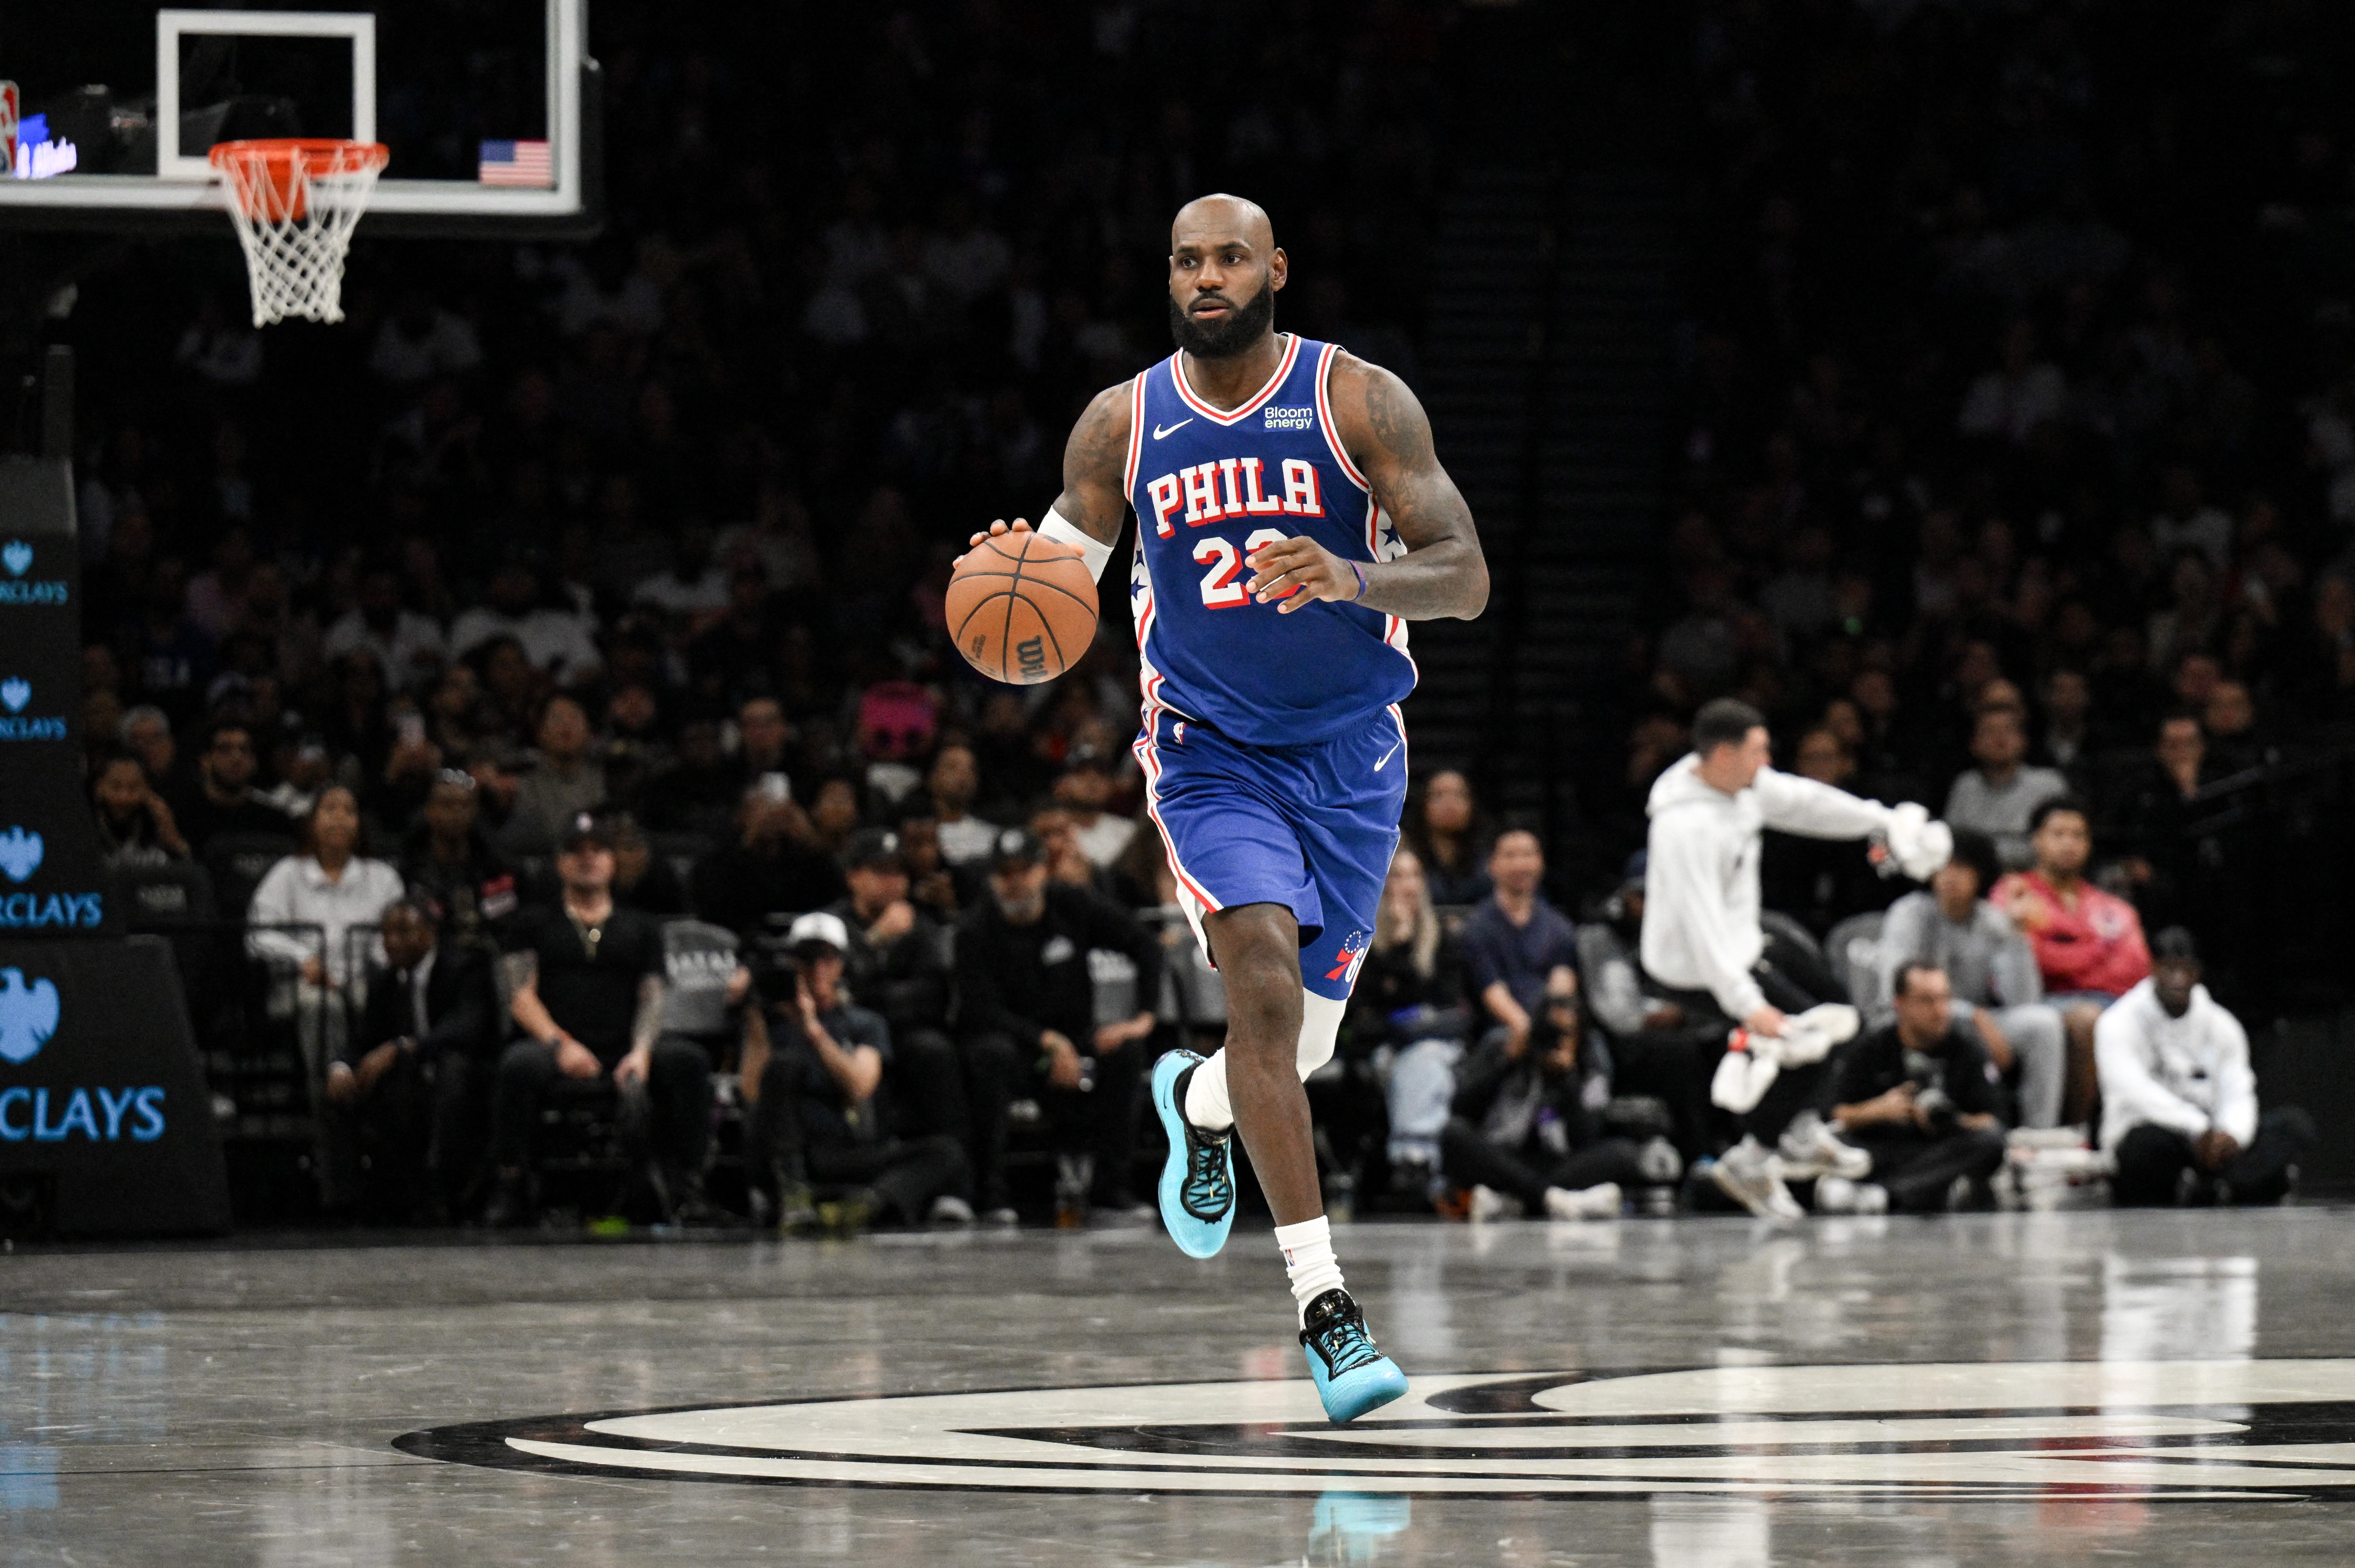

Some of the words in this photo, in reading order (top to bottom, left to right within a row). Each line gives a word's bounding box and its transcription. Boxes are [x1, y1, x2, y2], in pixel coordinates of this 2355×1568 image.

[1265, 406, 1312, 419] Bloom
[1265, 417, 1312, 429] energy
[1147, 457, 1325, 539] PHILA
[0, 1086, 166, 1142] CLAYS
